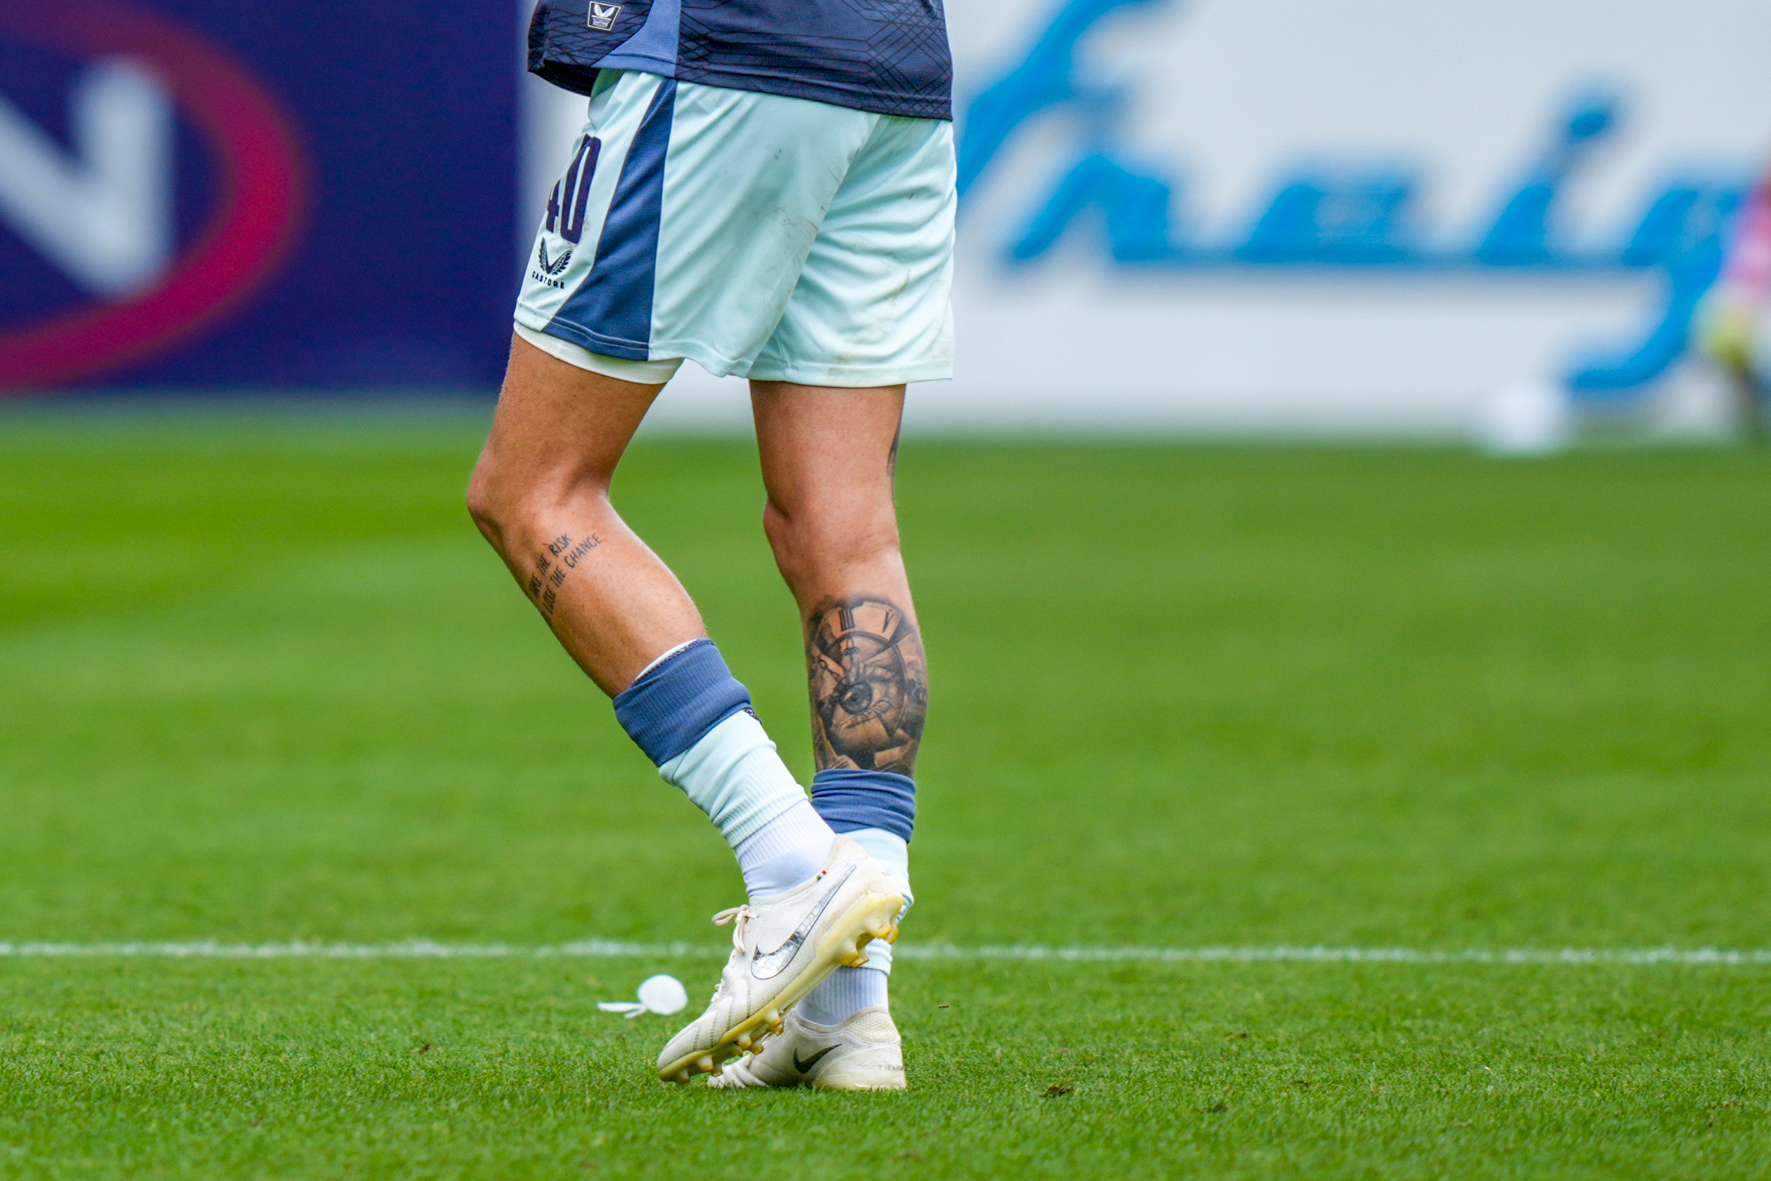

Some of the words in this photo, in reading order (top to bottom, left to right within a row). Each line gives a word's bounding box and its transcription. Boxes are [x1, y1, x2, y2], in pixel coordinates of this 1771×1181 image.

[545, 133, 602, 245] 40
[531, 270, 565, 290] CASTORE
[548, 533, 573, 558] RISK
[550, 565, 567, 588] THE
[564, 532, 603, 569] CHANCE
